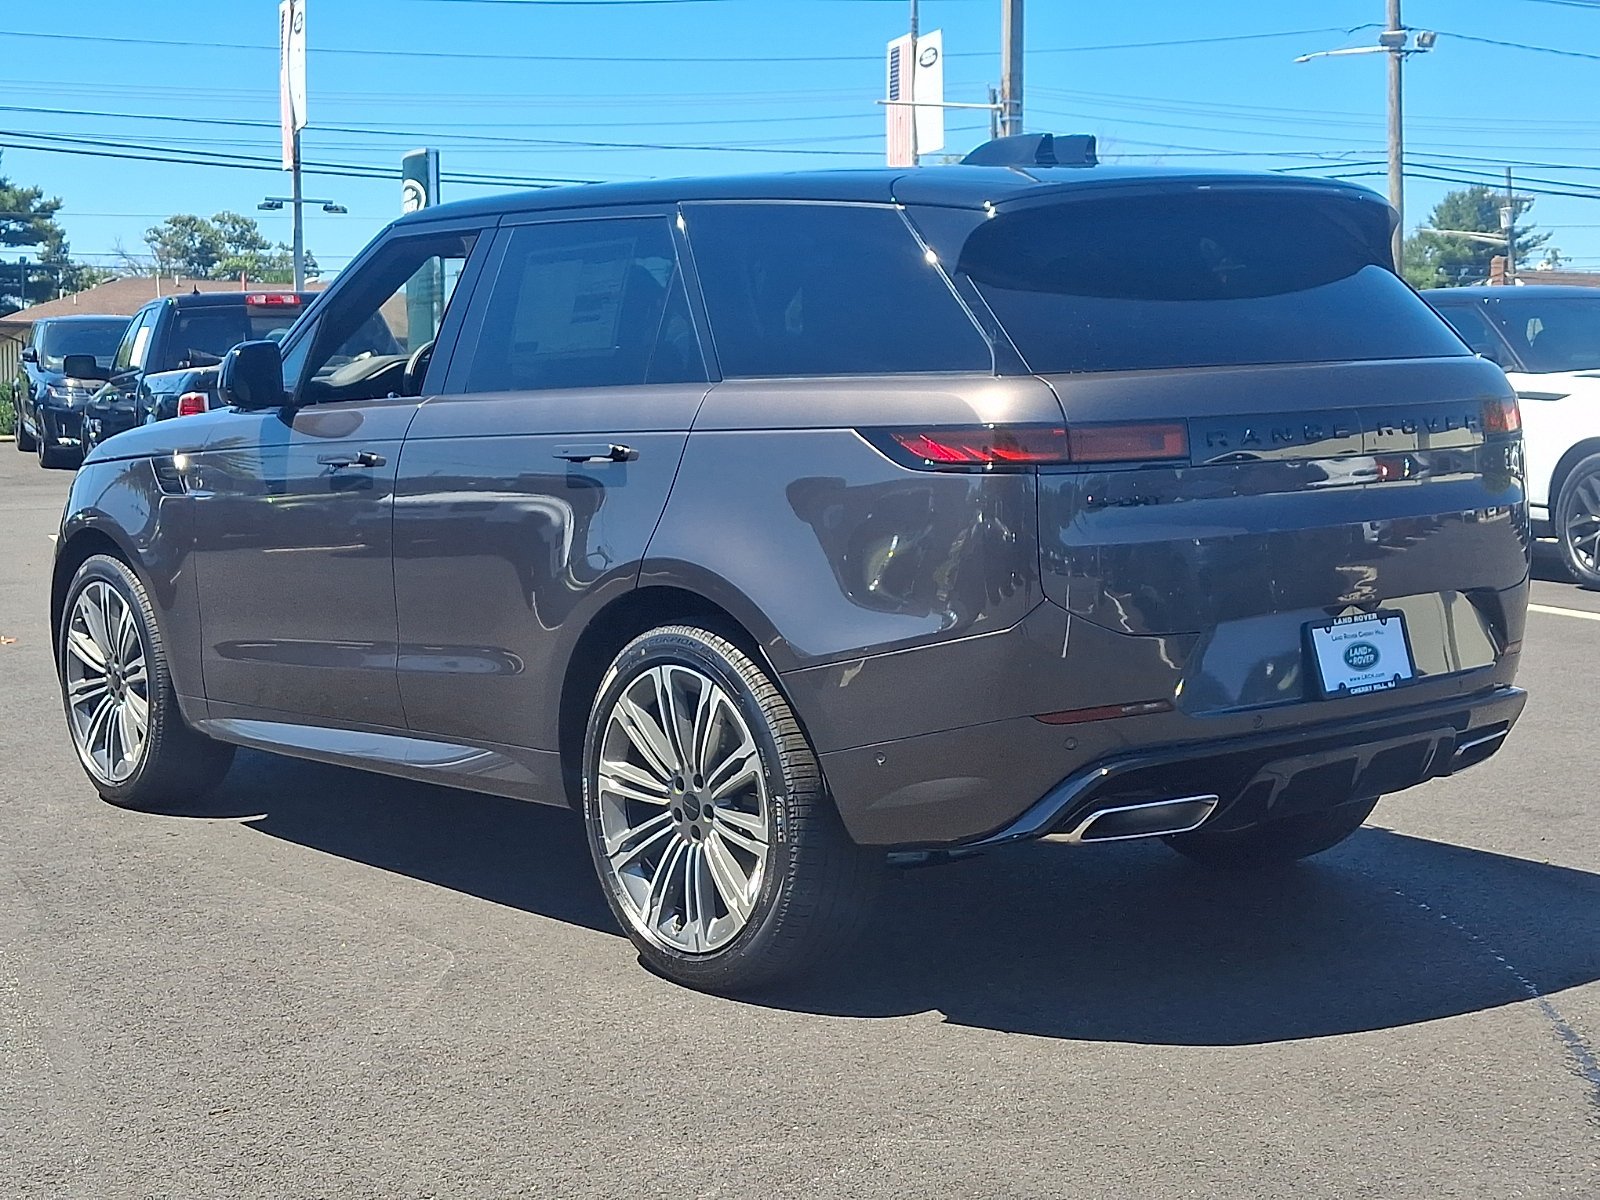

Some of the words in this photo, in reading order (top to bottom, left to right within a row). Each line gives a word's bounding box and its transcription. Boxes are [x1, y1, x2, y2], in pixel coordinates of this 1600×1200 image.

[1206, 423, 1350, 447] RANGE
[1377, 413, 1478, 436] ROVER
[1333, 616, 1352, 626] LAND
[1353, 613, 1378, 622] ROVER
[1350, 646, 1368, 657] LAND
[1353, 654, 1374, 664] ROVER
[1350, 686, 1372, 694] CHERRY
